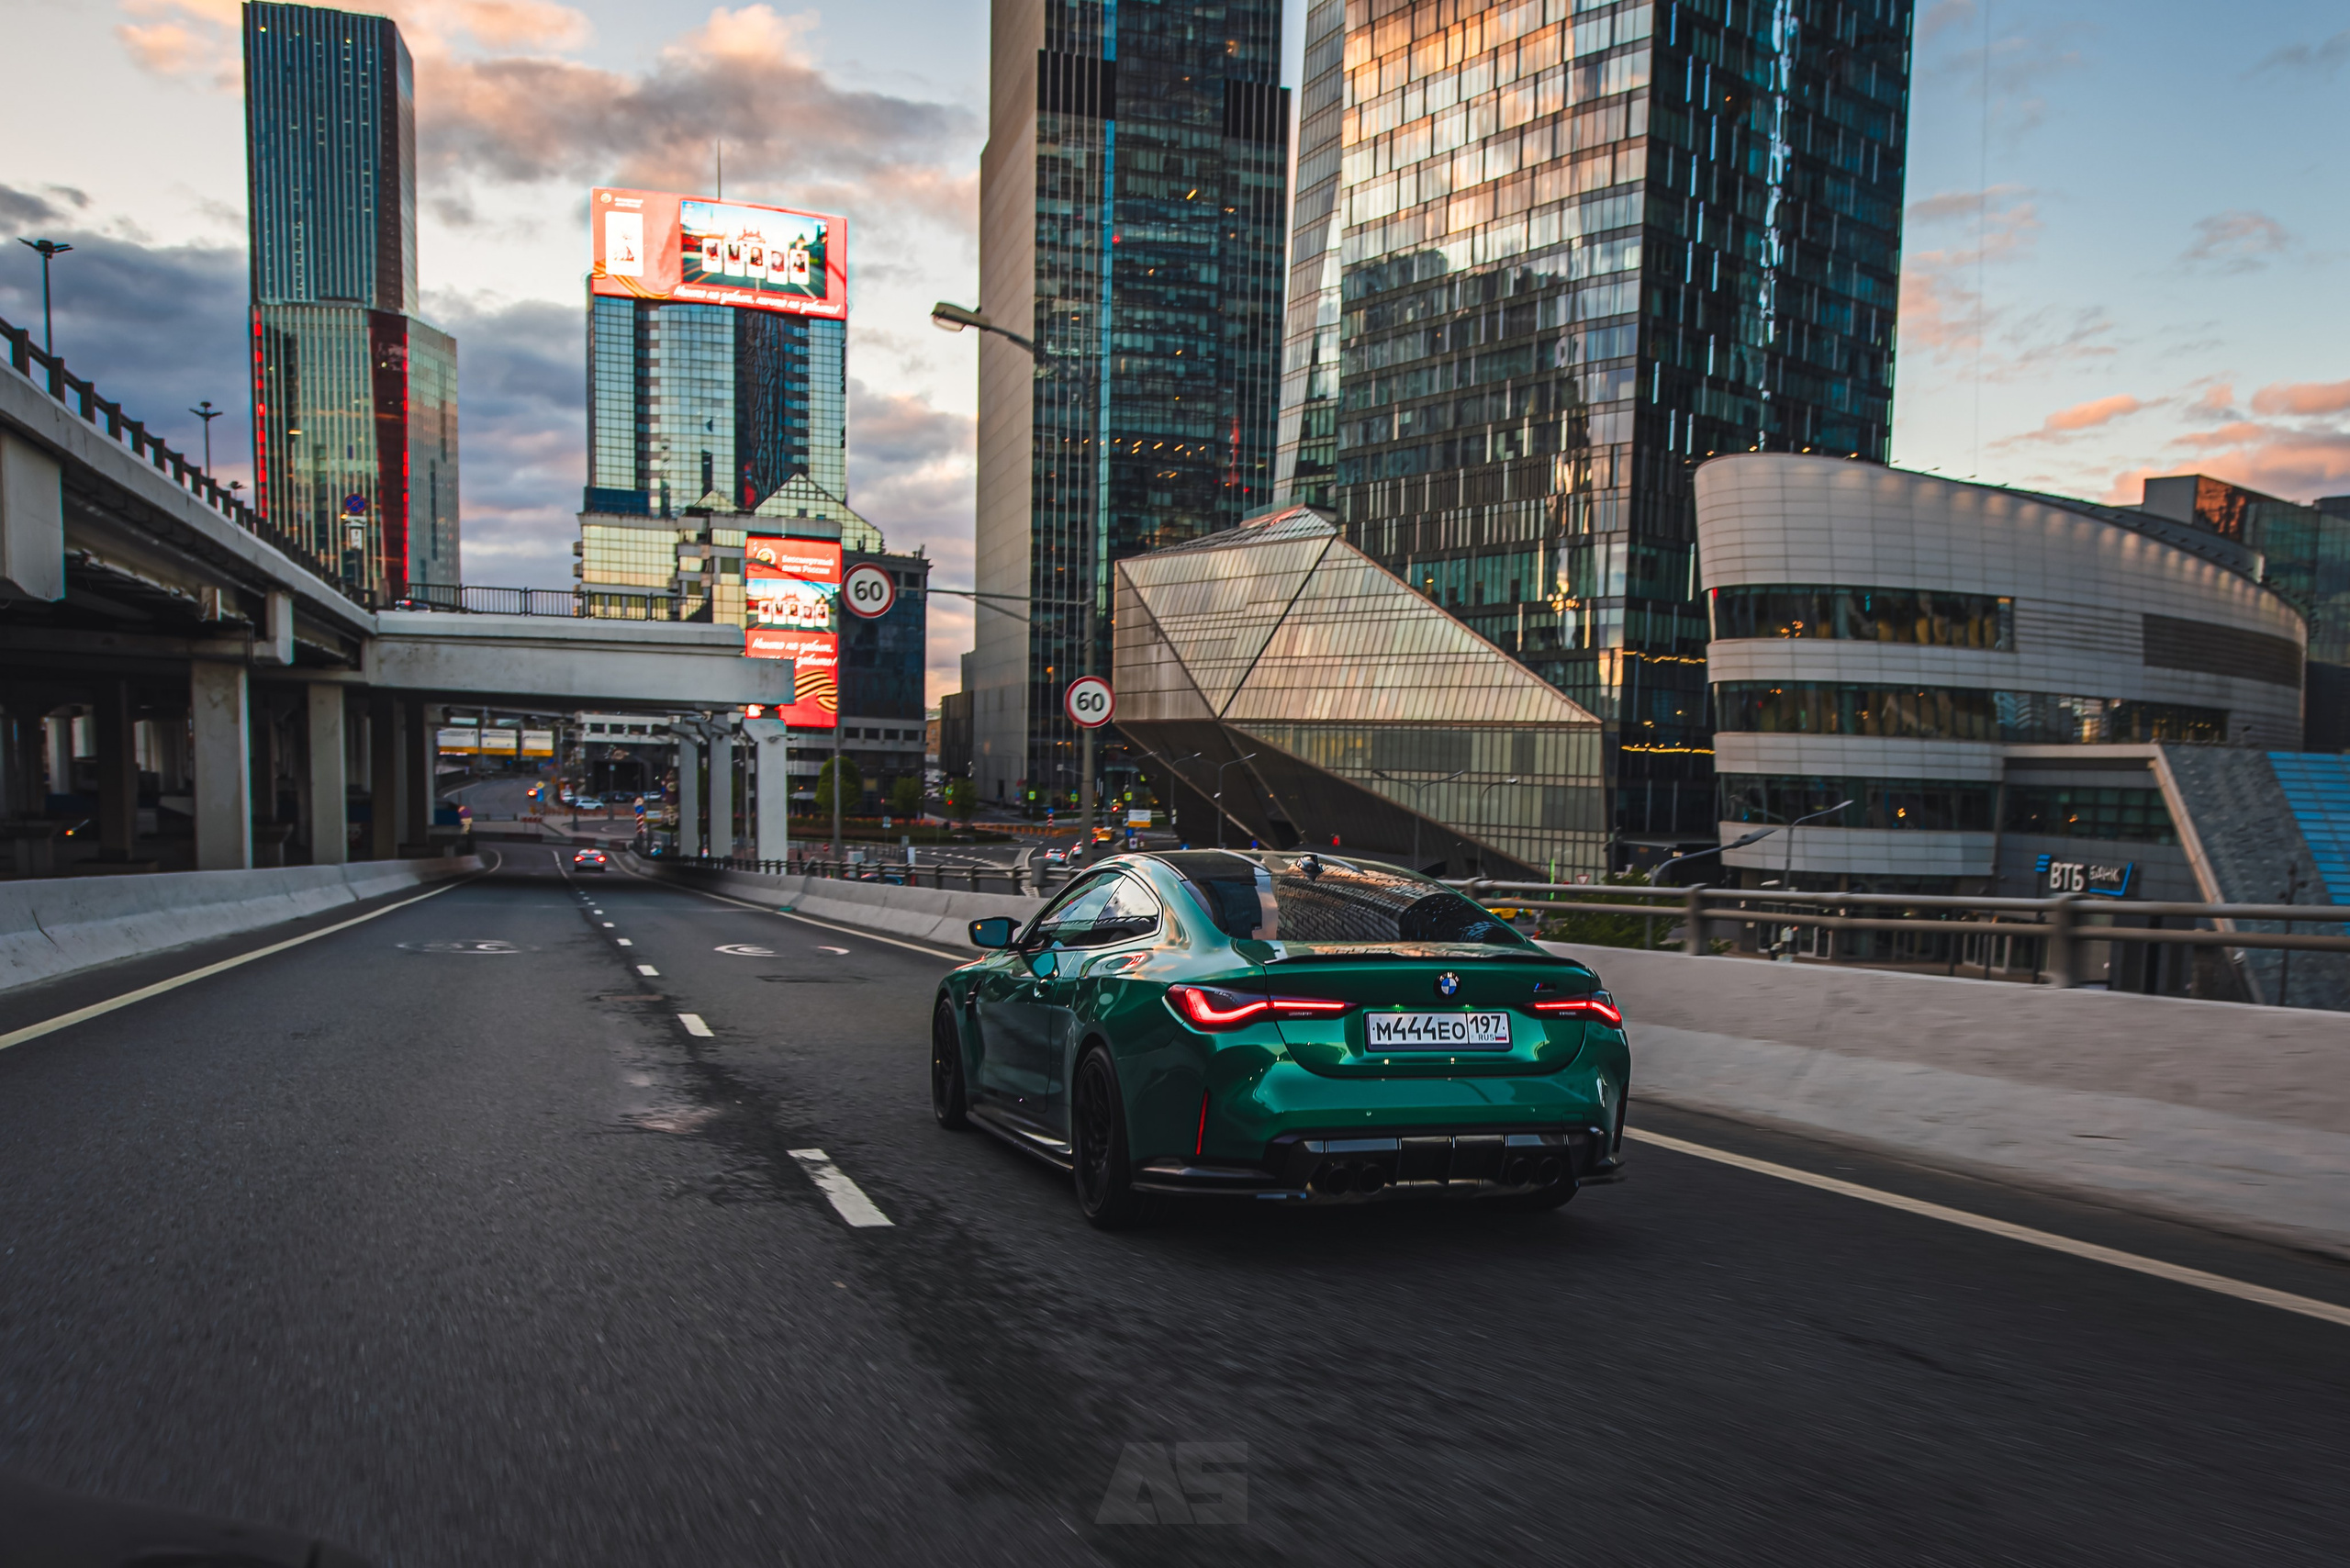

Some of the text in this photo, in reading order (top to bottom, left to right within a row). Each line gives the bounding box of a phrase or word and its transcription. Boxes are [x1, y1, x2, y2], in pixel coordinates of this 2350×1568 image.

[854, 580, 883, 601] 60
[1077, 691, 1105, 712] 60
[2050, 862, 2085, 891] ВТБ
[1470, 1015, 1501, 1034] 197
